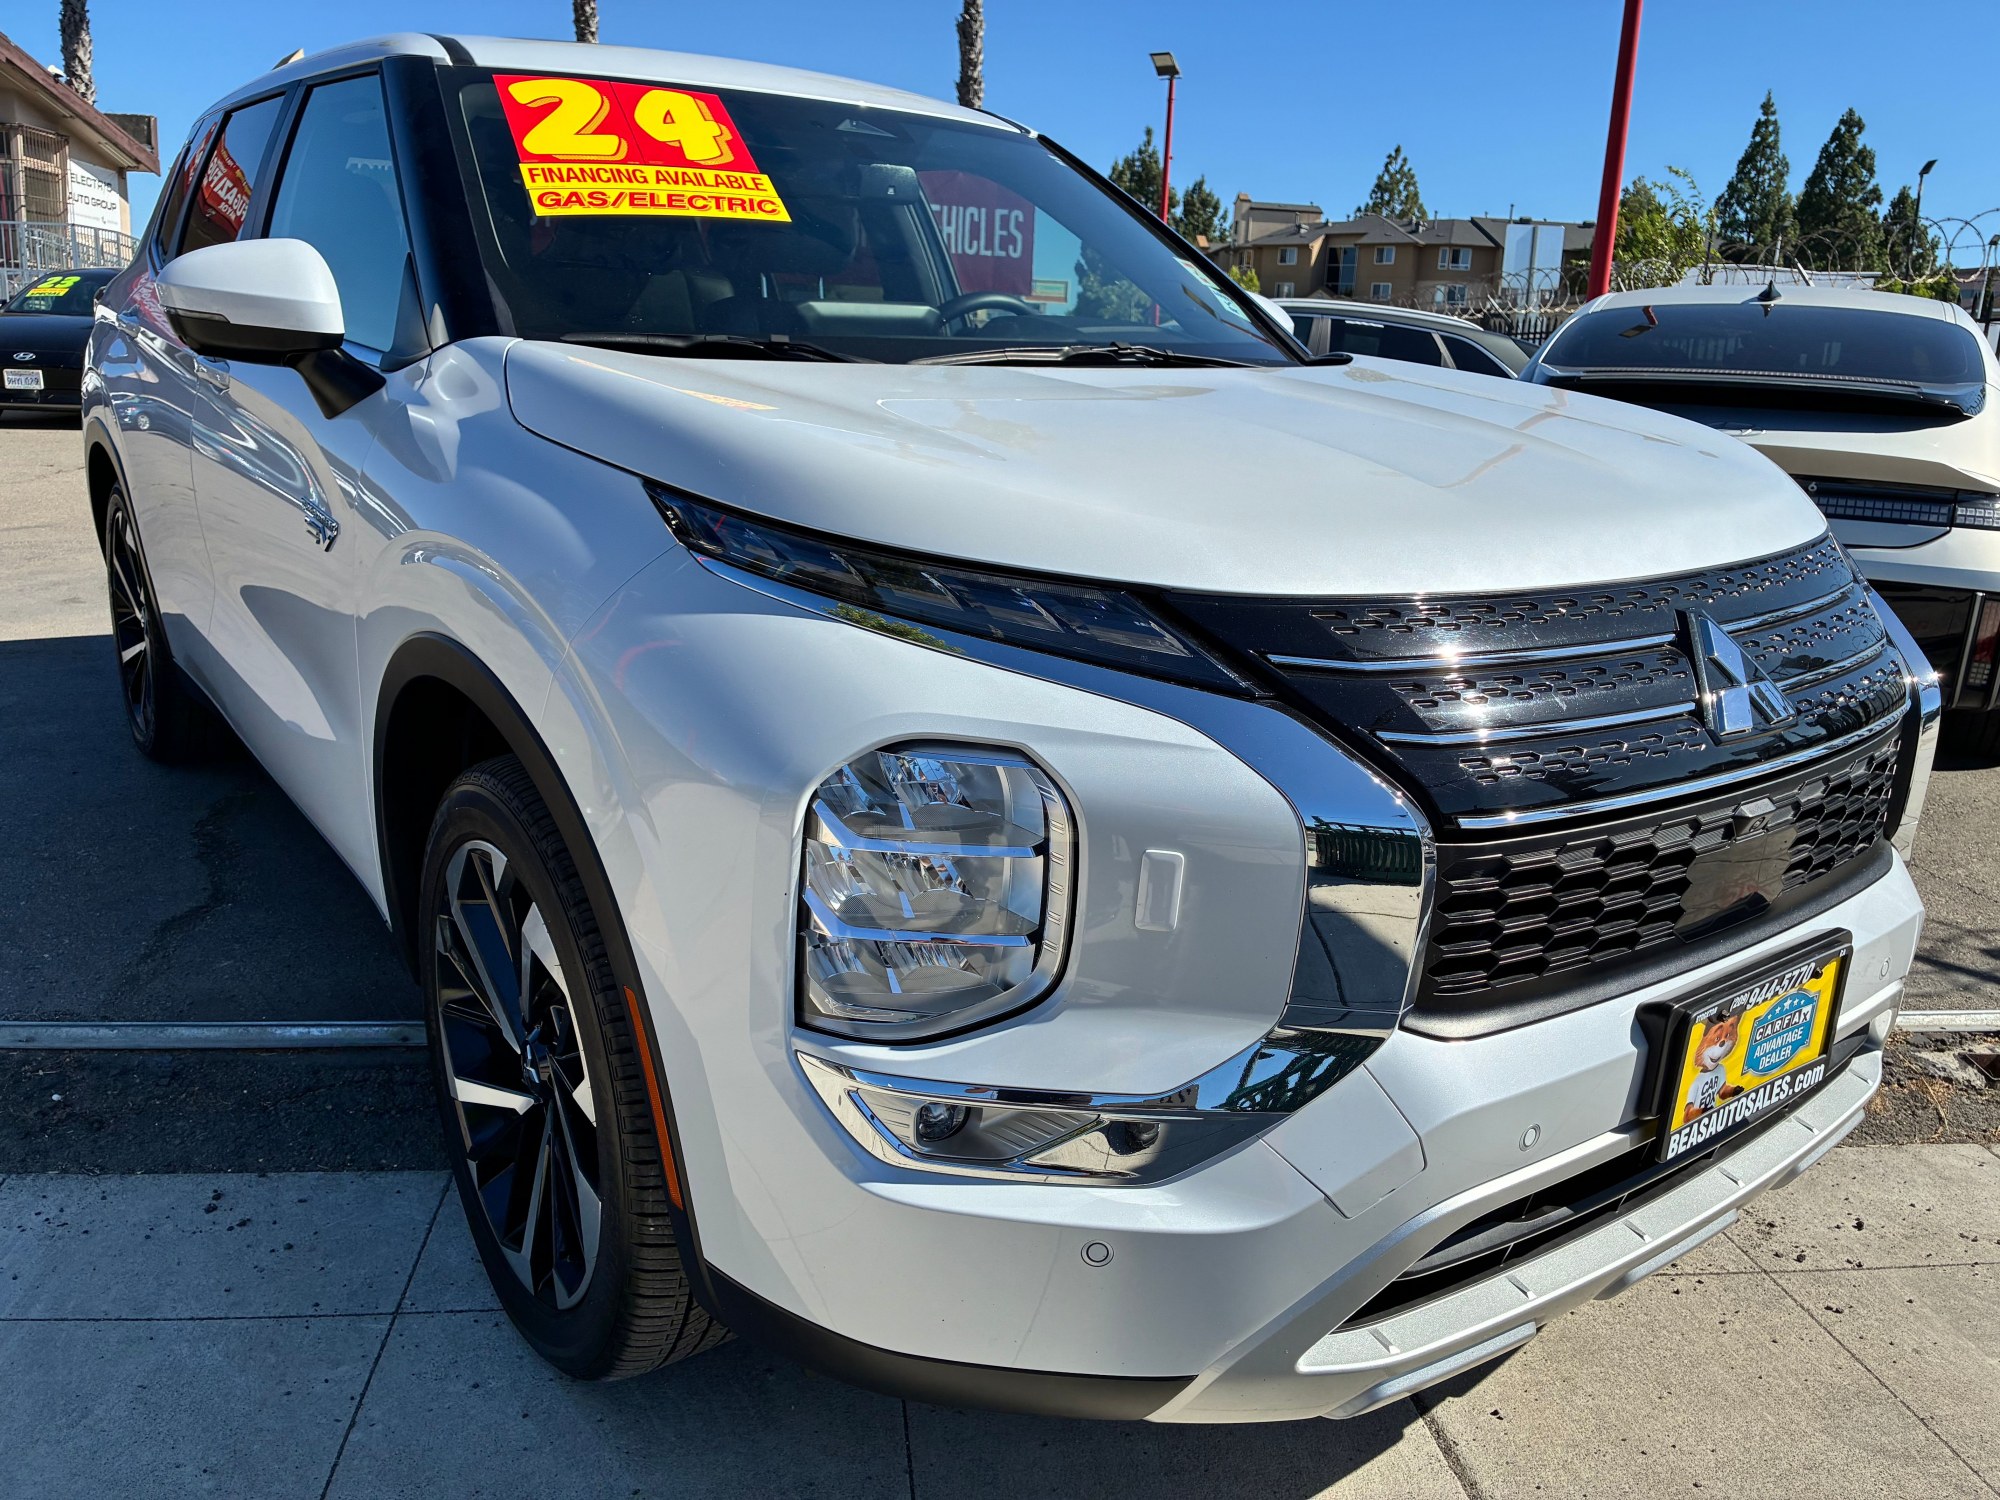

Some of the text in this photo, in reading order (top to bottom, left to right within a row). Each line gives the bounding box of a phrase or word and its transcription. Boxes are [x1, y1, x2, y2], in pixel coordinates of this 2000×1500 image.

[508, 79, 734, 165] 24
[527, 167, 768, 191] FINANCING AVAILABLE
[68, 192, 117, 211] AUTO GROUP
[537, 191, 781, 216] GAS/ELECTRIC
[37, 276, 81, 288] 23
[1807, 481, 1818, 492] 6
[1746, 962, 1815, 1010] 944-5770
[1756, 1006, 1812, 1041] CARFAX
[1754, 1026, 1804, 1059] ADVANTAGE
[1759, 1045, 1791, 1070] DEALER
[1701, 1075, 1719, 1097] CAR
[1699, 1089, 1717, 1109] FOX
[1667, 1064, 1825, 1160] BEASAUTOSALES.com
